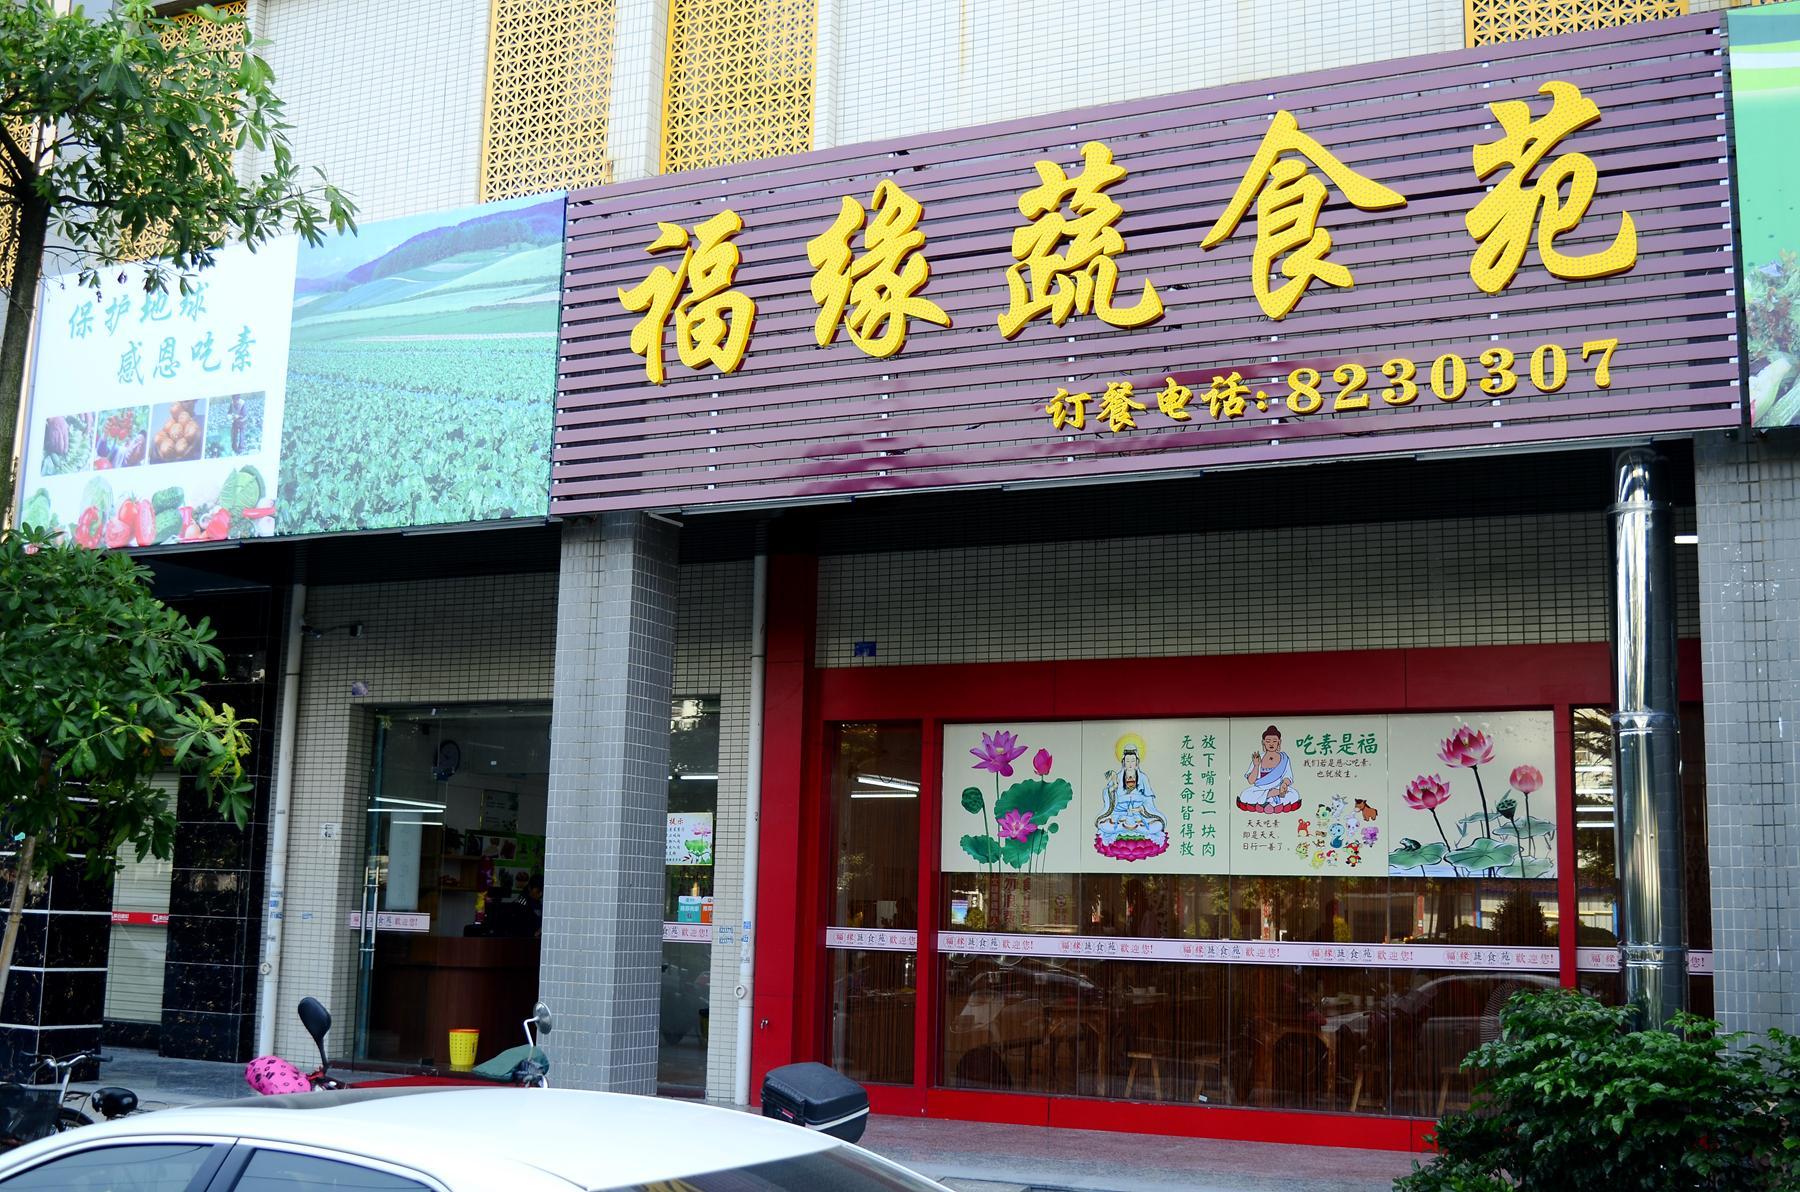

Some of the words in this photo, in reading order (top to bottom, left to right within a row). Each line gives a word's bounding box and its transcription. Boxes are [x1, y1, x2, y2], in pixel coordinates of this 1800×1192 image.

[617, 80, 1638, 386] 福缘蔬食苑
[68, 281, 209, 339] 保护地球
[117, 325, 257, 385] 感恩吃素
[1295, 733, 1378, 756] 吃素是福
[1180, 735, 1195, 857] 无数生命皆得救
[1201, 734, 1217, 857] 放下嘴边一块肉
[1247, 819, 1281, 828] 天天吃素
